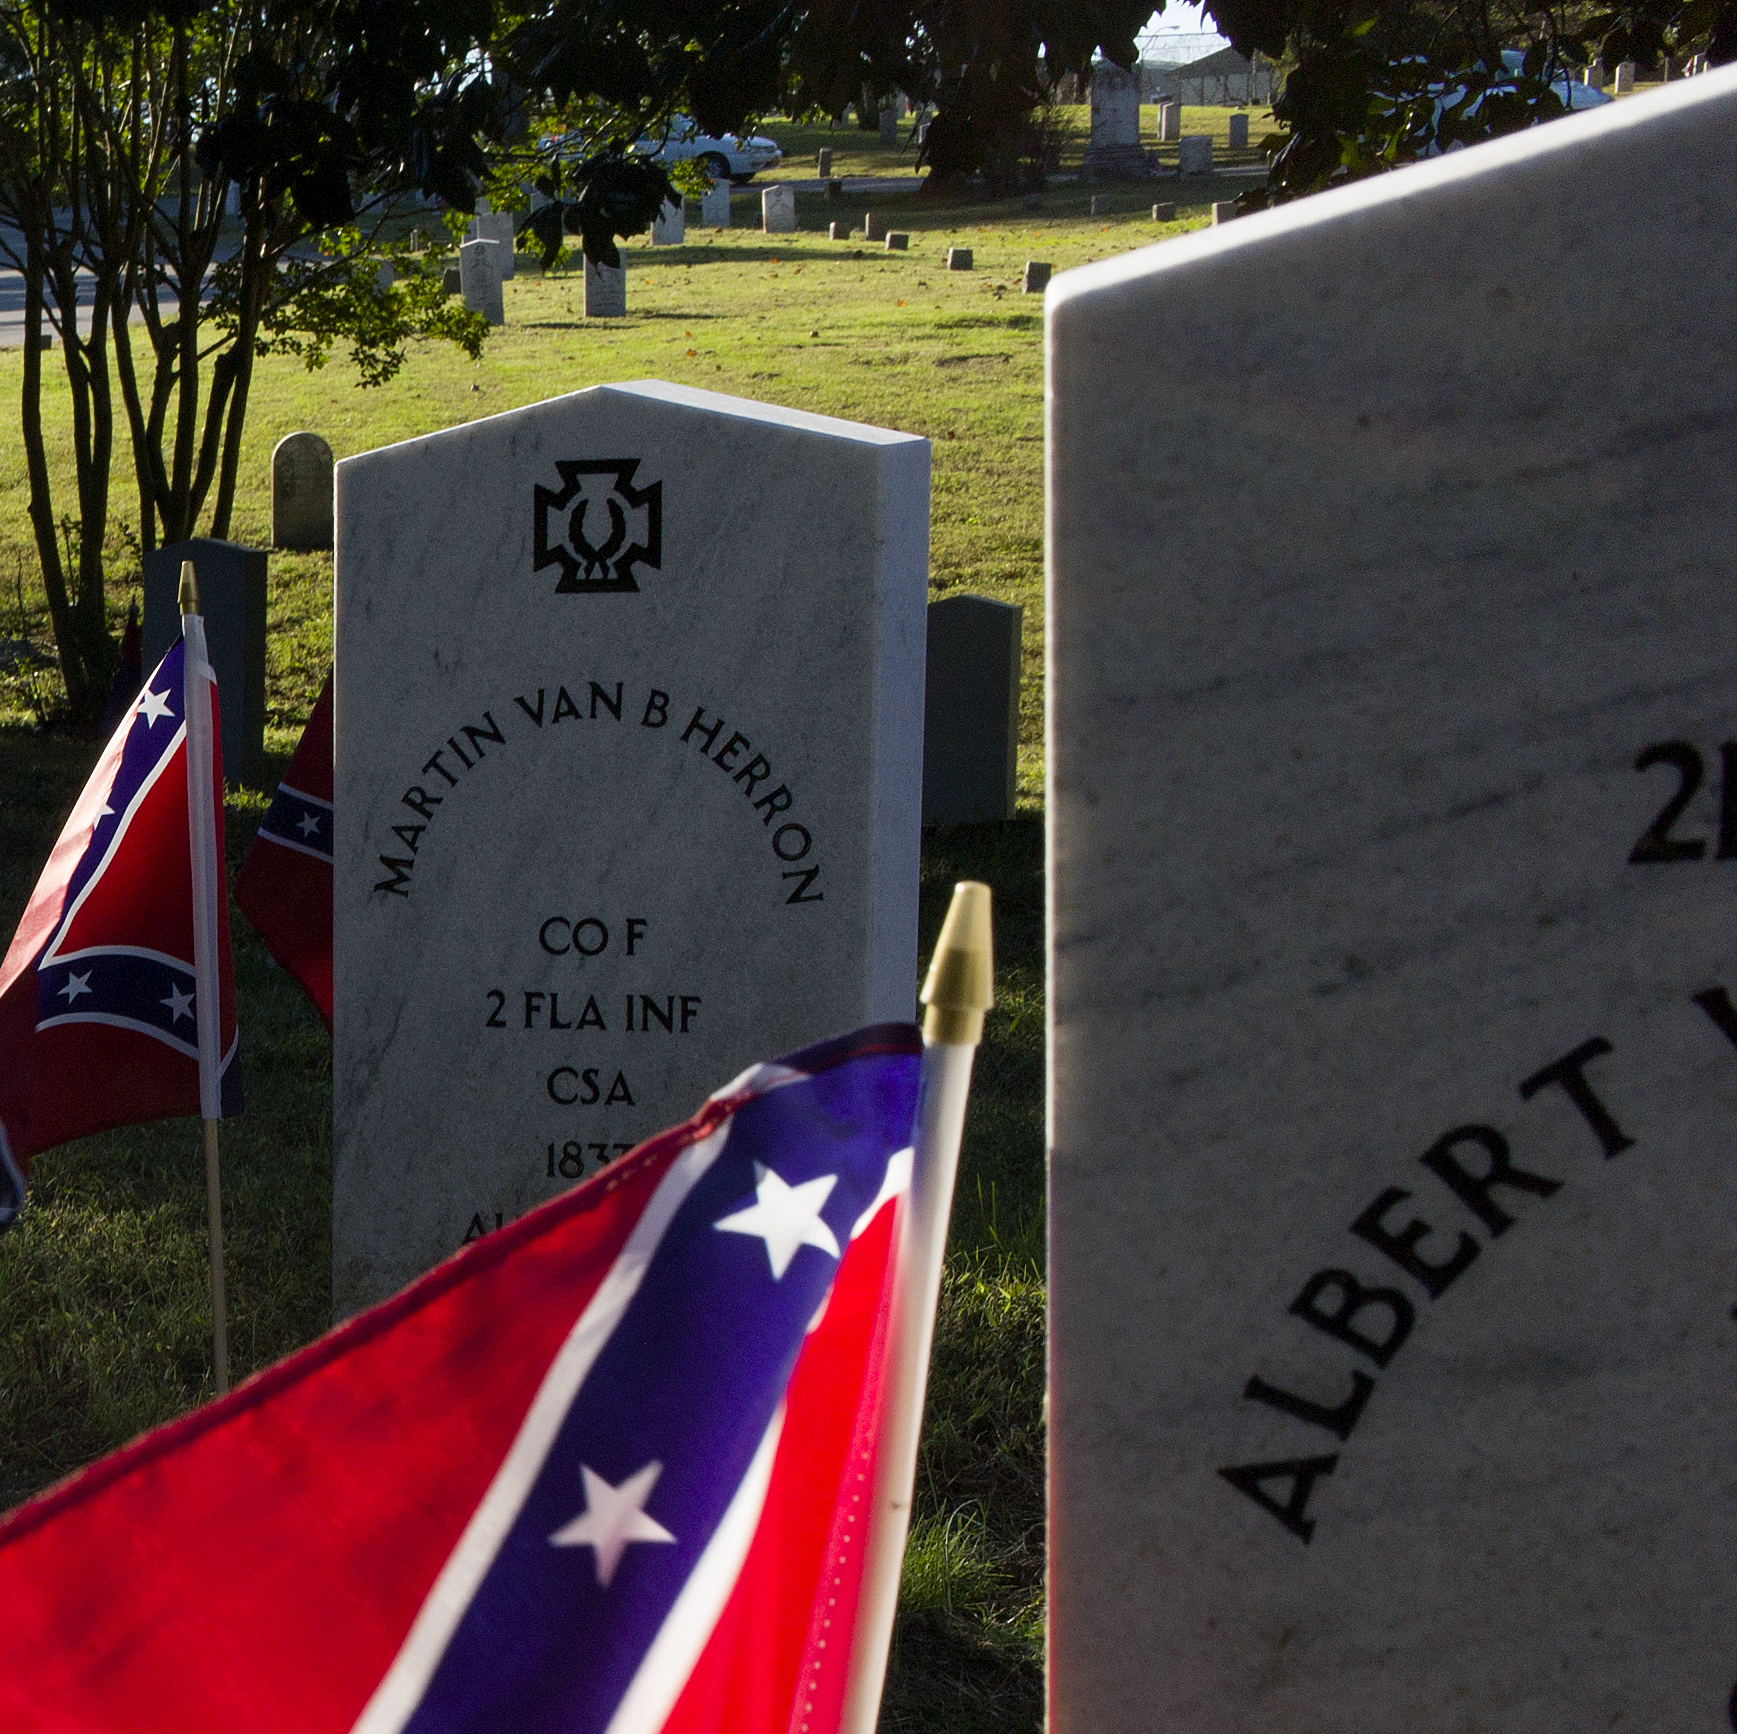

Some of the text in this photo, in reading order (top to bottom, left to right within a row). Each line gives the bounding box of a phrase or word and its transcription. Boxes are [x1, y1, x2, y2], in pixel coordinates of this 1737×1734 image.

[373, 681, 824, 905] MARTIN VAN B HERRON
[539, 916, 648, 957] CO F
[485, 989, 701, 1034] 2 FLA INF
[546, 1066, 636, 1107] CSA
[1218, 1035, 1637, 1546] ALBERT
